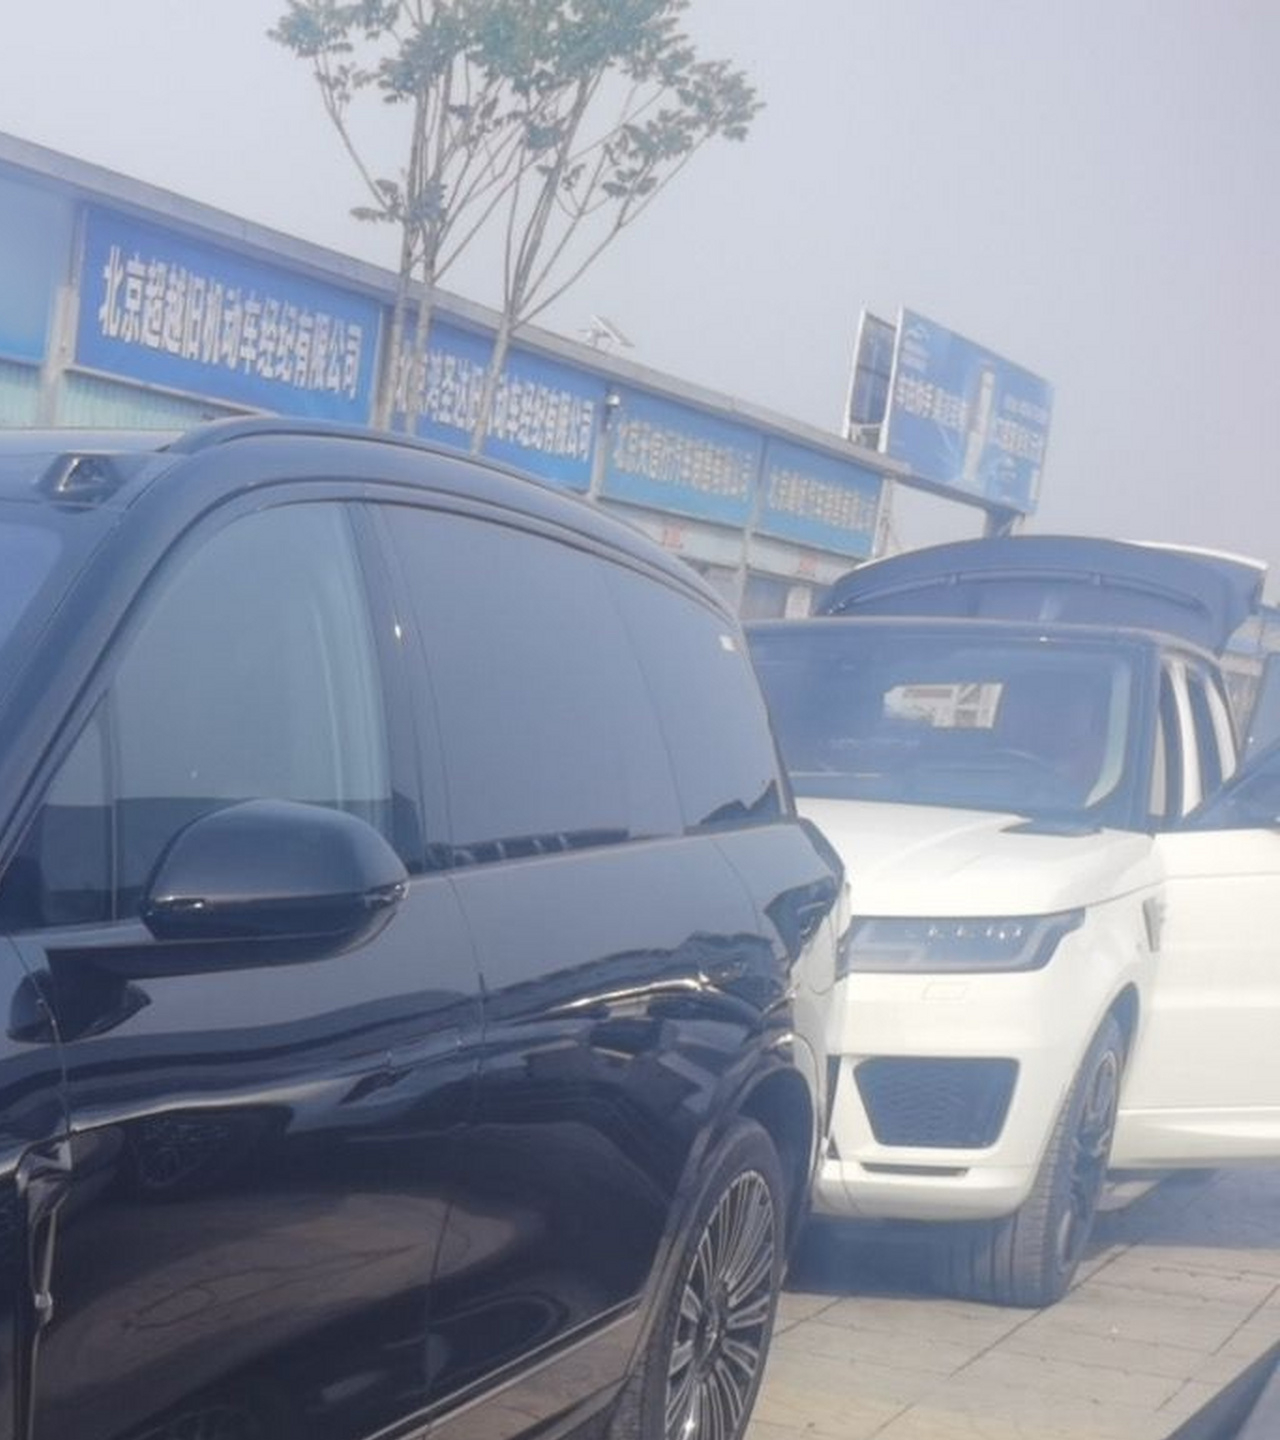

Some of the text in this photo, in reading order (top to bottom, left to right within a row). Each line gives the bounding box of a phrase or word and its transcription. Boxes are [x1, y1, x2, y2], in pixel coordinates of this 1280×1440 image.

[98, 244, 363, 397] 北京超越旧机动车经纪有限公司
